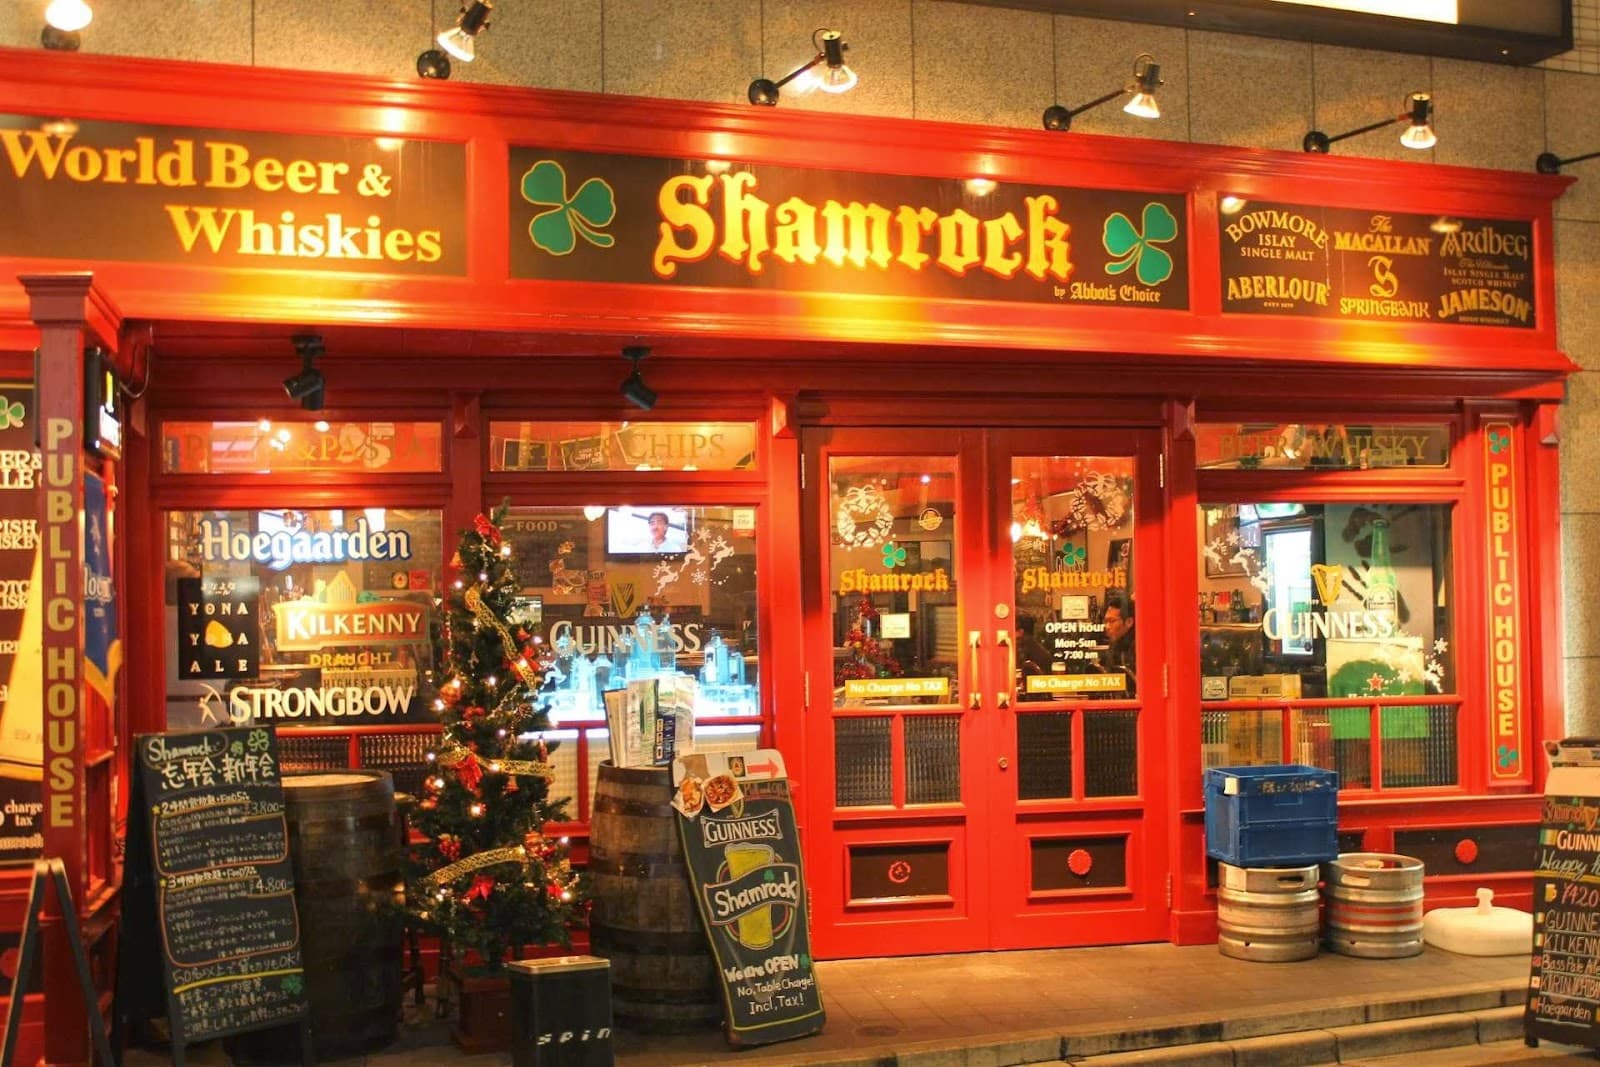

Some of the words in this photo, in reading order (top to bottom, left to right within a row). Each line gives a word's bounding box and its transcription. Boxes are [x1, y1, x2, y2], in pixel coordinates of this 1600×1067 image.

[0, 128, 196, 188] World
[204, 142, 348, 195] Beer
[357, 163, 392, 198] &
[165, 204, 442, 263] Whiskies
[652, 171, 1074, 283] Shamrock
[1225, 210, 1329, 249] BOWMORE
[1240, 246, 1282, 260] SINGLE
[1285, 250, 1315, 262] MALT
[1258, 233, 1297, 249] ISLAY
[1334, 231, 1432, 256] MACALLAN
[1053, 286, 1066, 300] by
[1119, 285, 1161, 304] Choice
[1227, 275, 1329, 306] ABERLOUR
[1438, 288, 1531, 322] JAMESON
[627, 433, 724, 460] CHIPS
[1308, 435, 1429, 460] WHISKY
[47, 418, 74, 632] PUBLIC
[516, 520, 558, 533] FOOD
[1491, 463, 1513, 607] PUBLIC
[200, 515, 412, 572] Hoegaarden
[838, 567, 950, 596] Shamrock
[1021, 565, 1127, 595] Shamrock
[188, 601, 249, 616] YONA
[286, 609, 422, 641] KILKENNY
[549, 619, 702, 655] GUINNESS
[1045, 622, 1077, 633] OPEN
[1079, 621, 1105, 633] hour
[1262, 607, 1394, 641] GUINNESS
[188, 632, 249, 647] YA
[1054, 637, 1097, 649] Mon-Sun
[189, 659, 248, 673] ALE
[309, 651, 392, 668] DRAUGHT
[1085, 651, 1098, 660] am
[1495, 615, 1515, 737] HOUSE
[229, 685, 414, 724] STRONGBOW
[47, 647, 75, 828] HOUSE
[4, 799, 44, 816] charge
[15, 813, 33, 827] tax
[705, 818, 777, 843] GUINNESS
[1539, 848, 1588, 881] Happy
[714, 871, 798, 917] Shamrock
[724, 965, 743, 983] We
[764, 953, 799, 976] OPEN
[1541, 953, 1565, 973] Bass
[1566, 956, 1585, 975] Pale
[755, 977, 781, 994] Table
[781, 972, 815, 991] Charge!
[1540, 971, 1571, 994] KIRIN
[779, 991, 804, 1008] Tax!
[536, 1026, 612, 1046] spin
